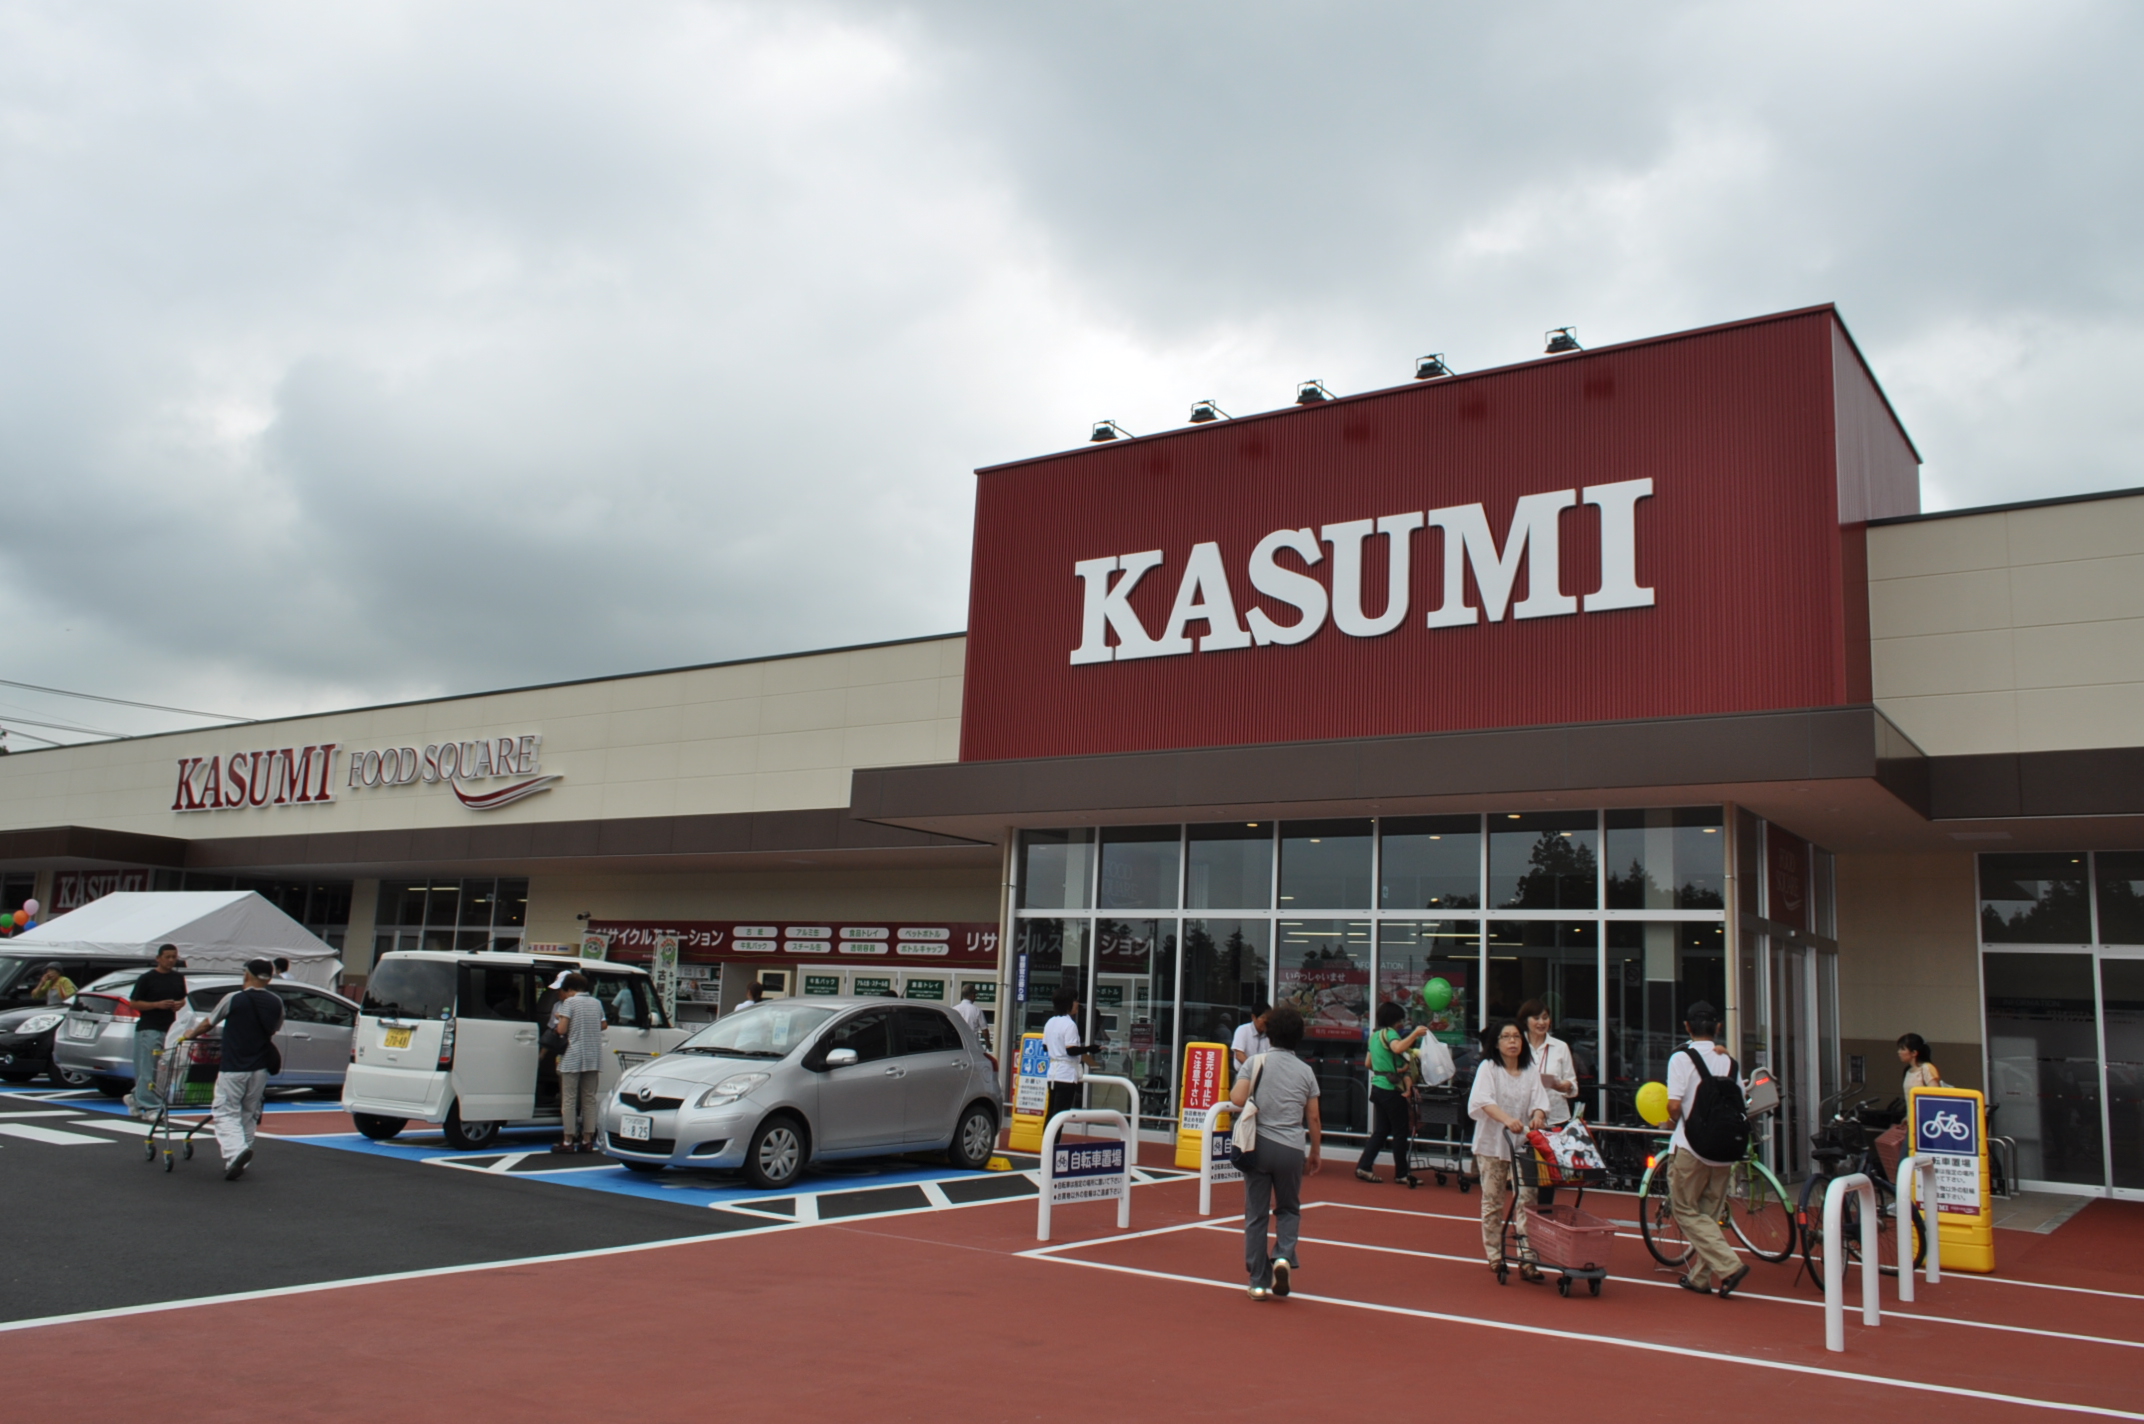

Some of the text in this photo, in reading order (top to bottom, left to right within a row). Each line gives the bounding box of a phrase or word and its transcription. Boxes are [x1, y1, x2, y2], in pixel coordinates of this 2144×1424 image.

[1070, 477, 1656, 665] KASUMI
[171, 735, 542, 812] KASUMI FOOD SQUARE
[795, 928, 820, 937] アルミ缶
[849, 929, 879, 938] 食品トレイ
[905, 929, 941, 939] ペットボトル
[740, 941, 768, 950] 牛乳パック
[792, 943, 822, 952] スチール缶
[901, 944, 944, 954] ボトルキャップ
[1355, 961, 1404, 970] INFOATION
[1285, 971, 1346, 983] いらっしゃいませ
[1190, 1050, 1203, 1107] ご注意下さい
[1202, 1051, 1216, 1108] 足元の車止に
[1071, 1148, 1122, 1170] 自転車置場
[1931, 1156, 1972, 1168] 転車置場
